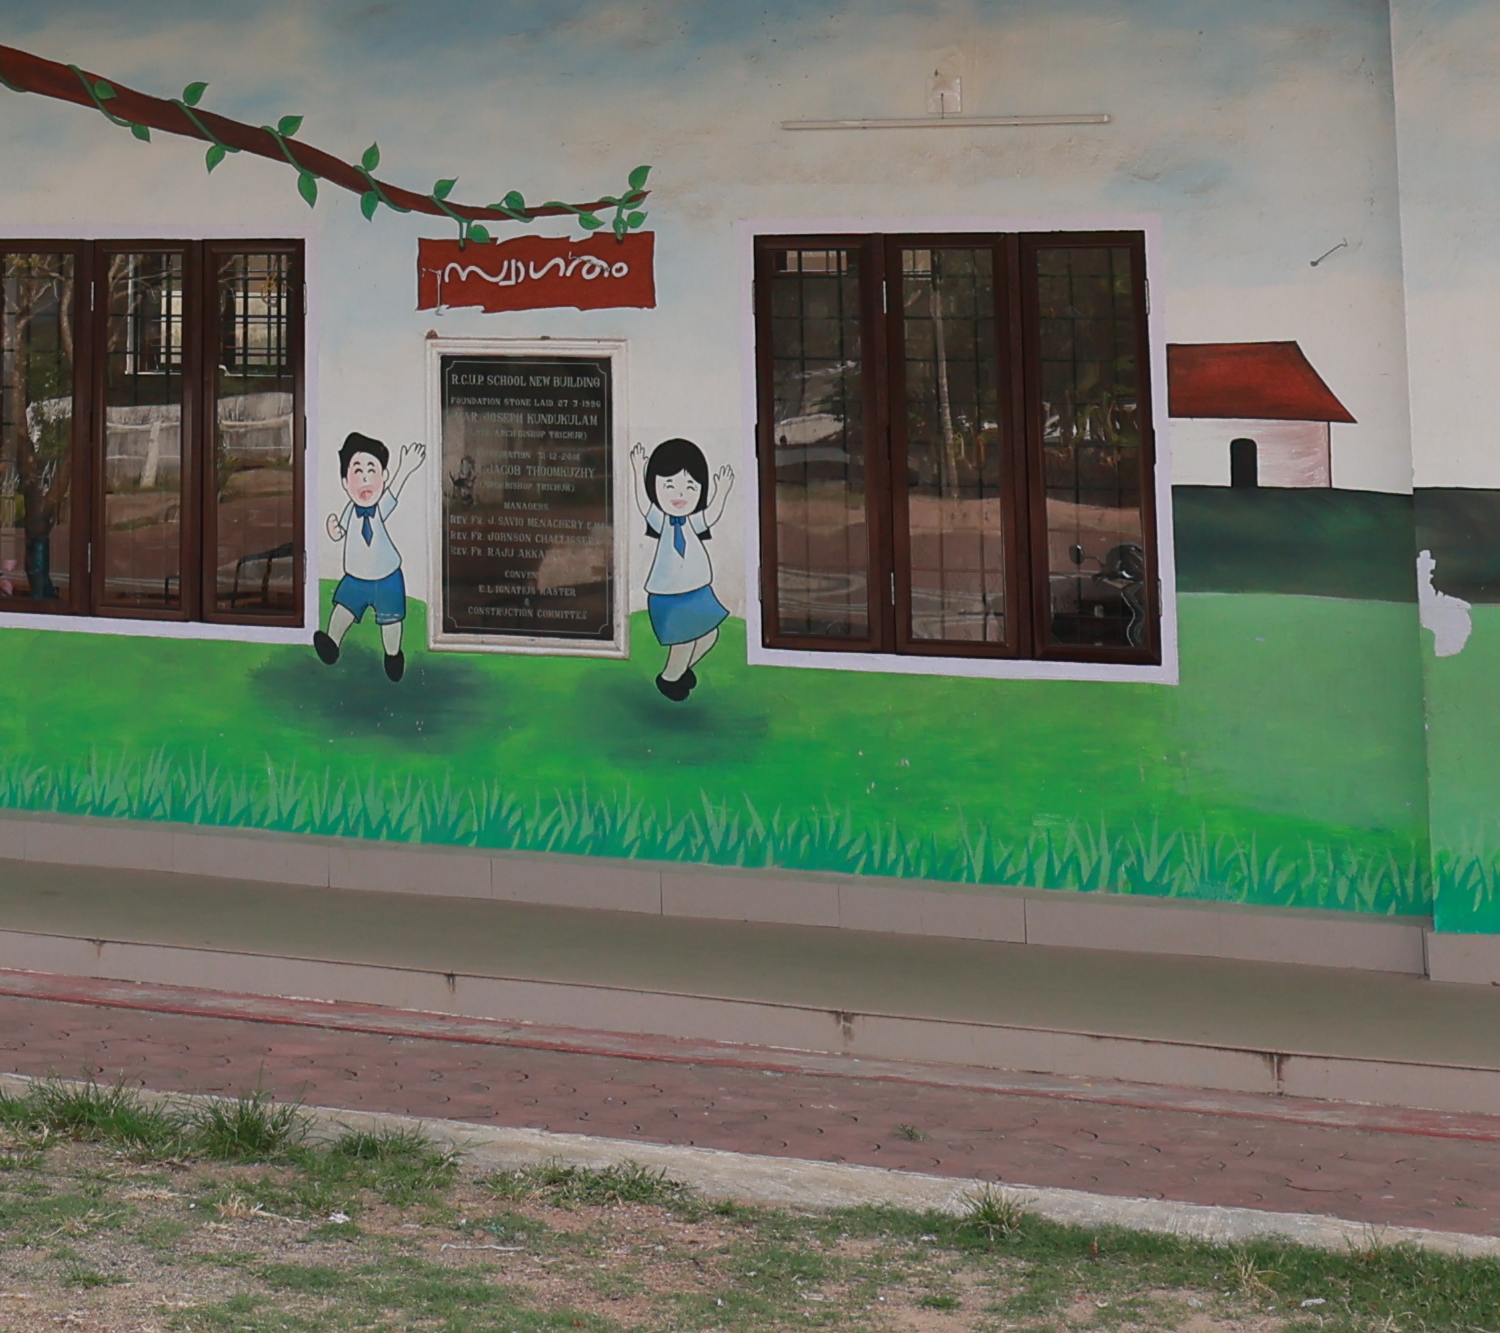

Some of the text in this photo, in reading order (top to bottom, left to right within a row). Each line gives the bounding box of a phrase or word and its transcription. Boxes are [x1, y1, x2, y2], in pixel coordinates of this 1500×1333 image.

[444, 255, 628, 286] സ്വാഗതം
[487, 375, 527, 386] SCHOOL
[529, 376, 551, 387] NEW
[553, 376, 601, 388] BUILDING
[450, 397, 501, 405] FOUNDATION
[504, 398, 532, 406] STONE
[534, 399, 554, 407] LAID
[484, 412, 524, 424] JOSEPH
[527, 413, 598, 426] KUNDUKULAM
[486, 464, 521, 475] JACOB
[504, 502, 549, 511] MANAGERS
[488, 532, 532, 543] JOHNSON
[488, 547, 514, 557] RAJU
[540, 587, 576, 597] MASTER
[467, 606, 588, 620] CONSTRUCTION COMMITTEE
